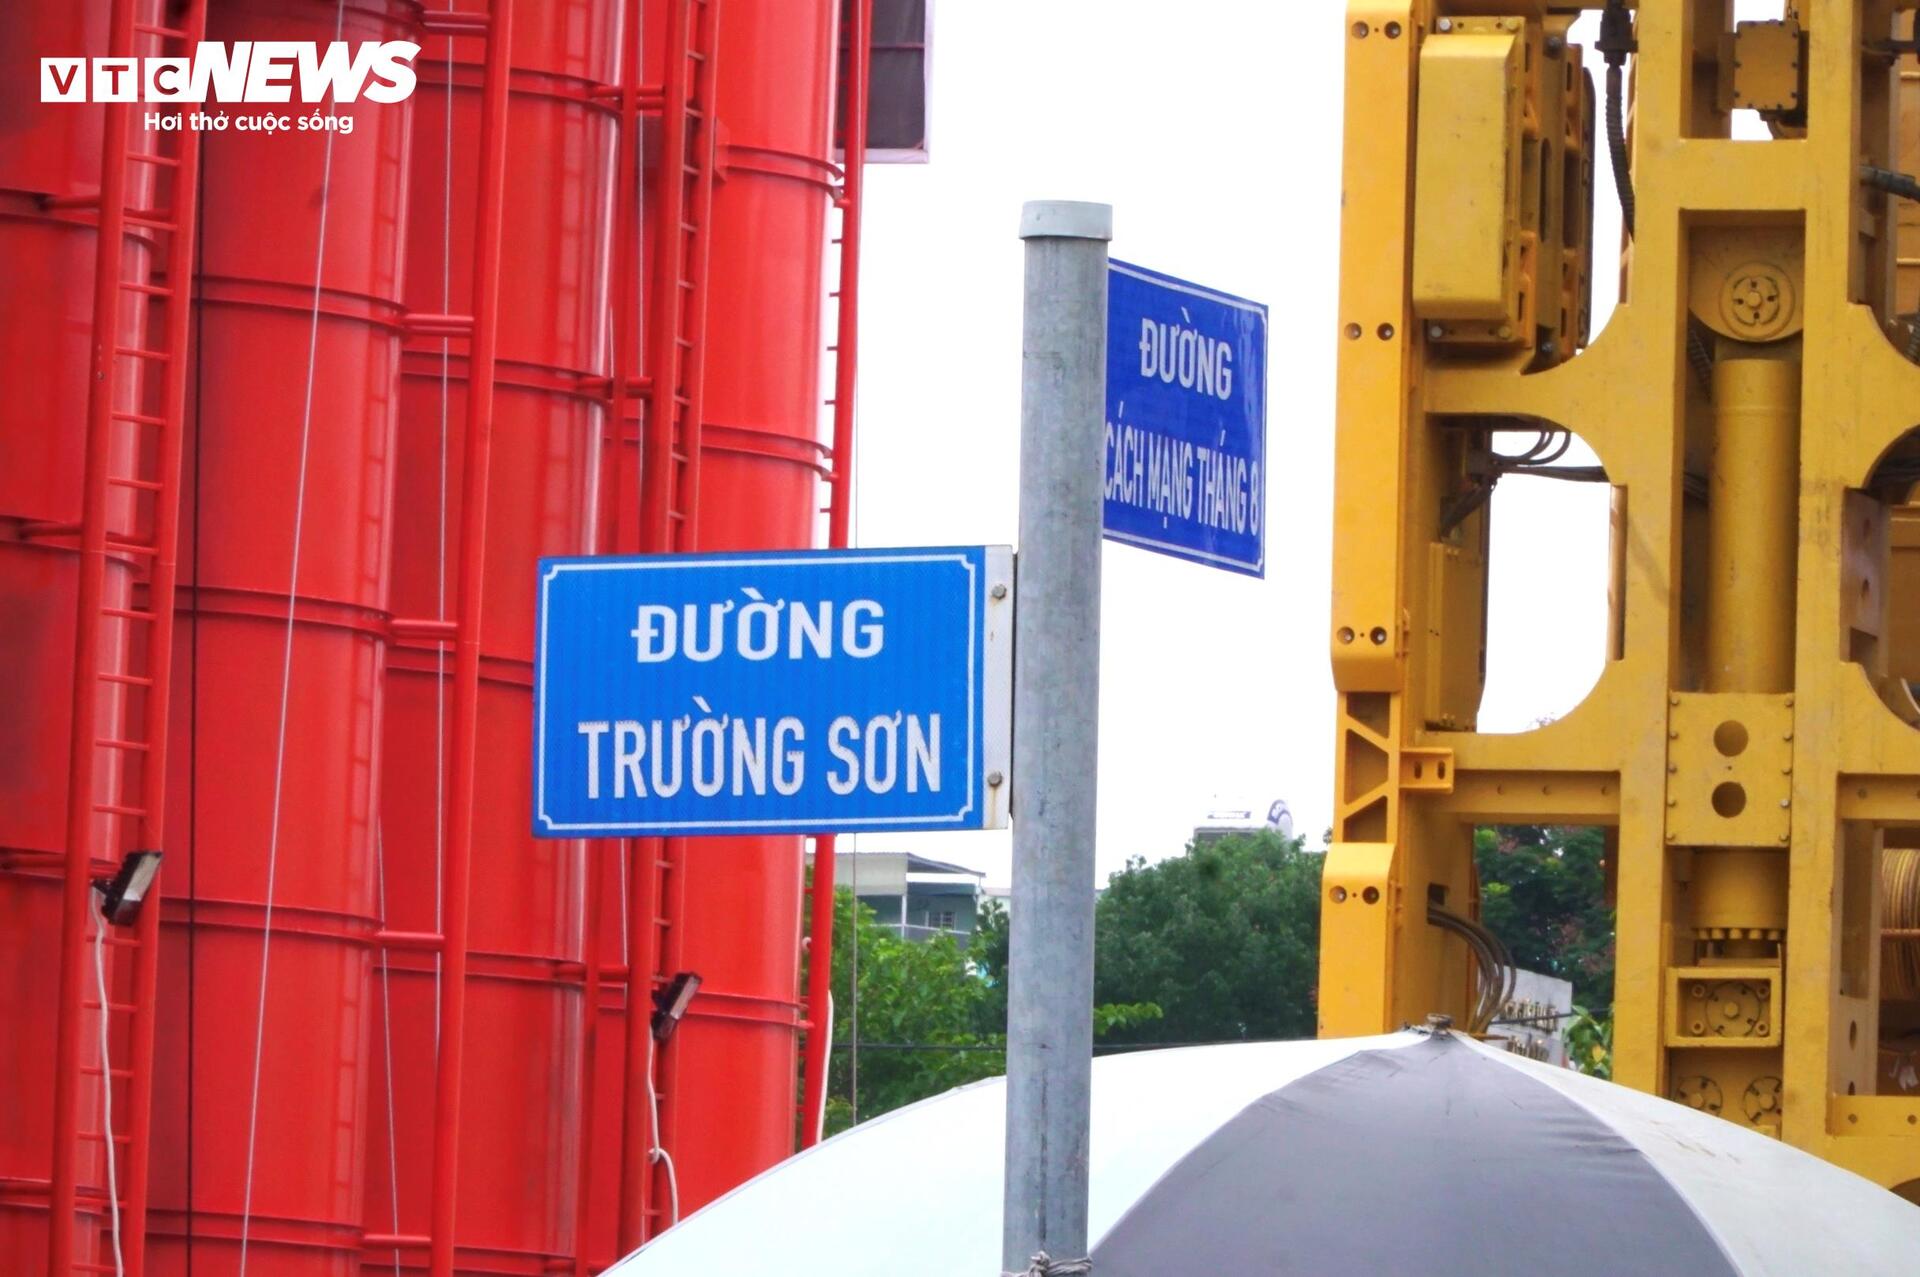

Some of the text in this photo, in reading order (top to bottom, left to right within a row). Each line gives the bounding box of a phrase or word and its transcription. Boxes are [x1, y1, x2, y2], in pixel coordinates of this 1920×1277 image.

[1139, 306, 1233, 400] ĐƯỜNG
[1104, 401, 1260, 537] CÁCH MẠNG THÁNG 8
[631, 587, 884, 662] ĐƯỜNG
[578, 695, 941, 799] TRƯỜNG SƠN
